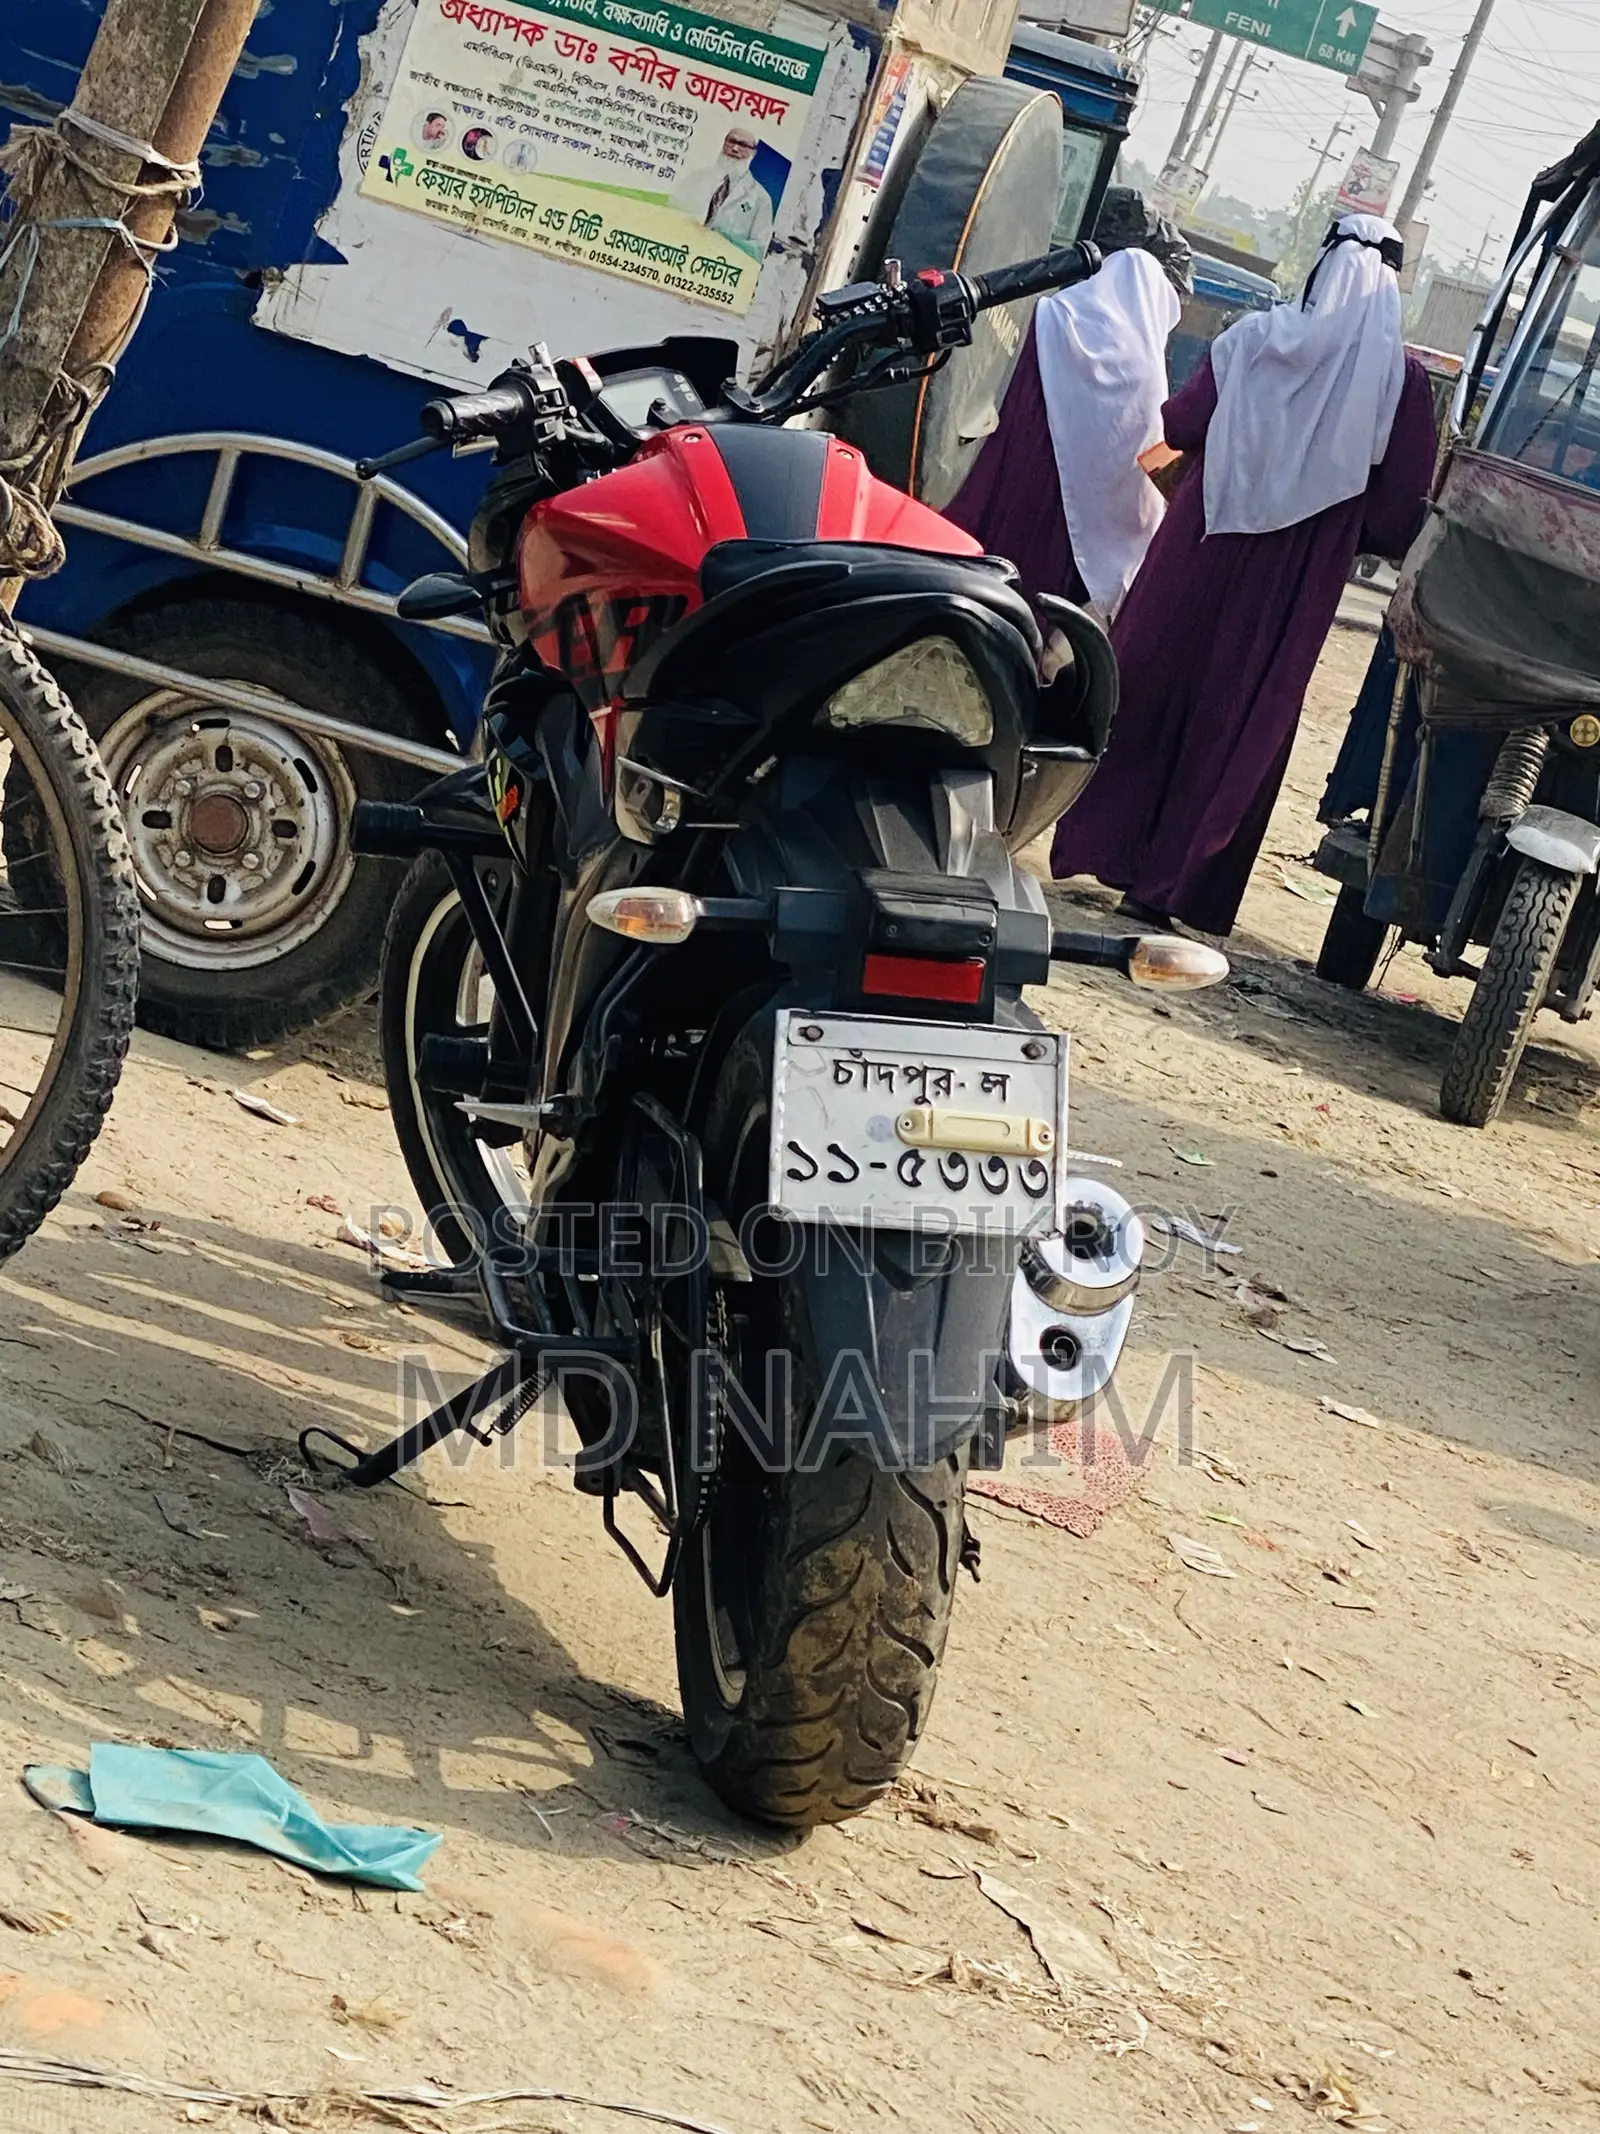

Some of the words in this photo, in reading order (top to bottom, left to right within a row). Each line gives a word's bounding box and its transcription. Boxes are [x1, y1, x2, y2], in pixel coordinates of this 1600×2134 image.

[603, 1, 669, 36] বক্ষব্যাধি
[670, 23, 683, 41] ও
[685, 26, 746, 60] মেডিসিন
[747, 40, 809, 79] বিশেষজ্ঞ
[1225, 10, 1272, 38] FENI
[439, 0, 548, 47] অধ্যাপক
[555, 30, 598, 64] ডাঃ
[608, 47, 680, 90] বশীর
[684, 71, 790, 126] আহাম্মদ
[1335, 48, 1357, 67] KM
[494, 114, 517, 131] প্রতি
[518, 123, 560, 143] সোমবার
[562, 136, 592, 154] সকাল
[415, 168, 468, 200] ফেয়ার
[469, 184, 538, 223] হসপিটাল
[568, 208, 603, 242] সিটি
[603, 229, 689, 273] এমআরআই
[690, 255, 743, 289] সেন্টার
[663, 273, 734, 305] 01322-235552
[981, 1071, 1010, 1103] ল
[785, 1140, 1051, 1200] ১১-৫৩৩৩
